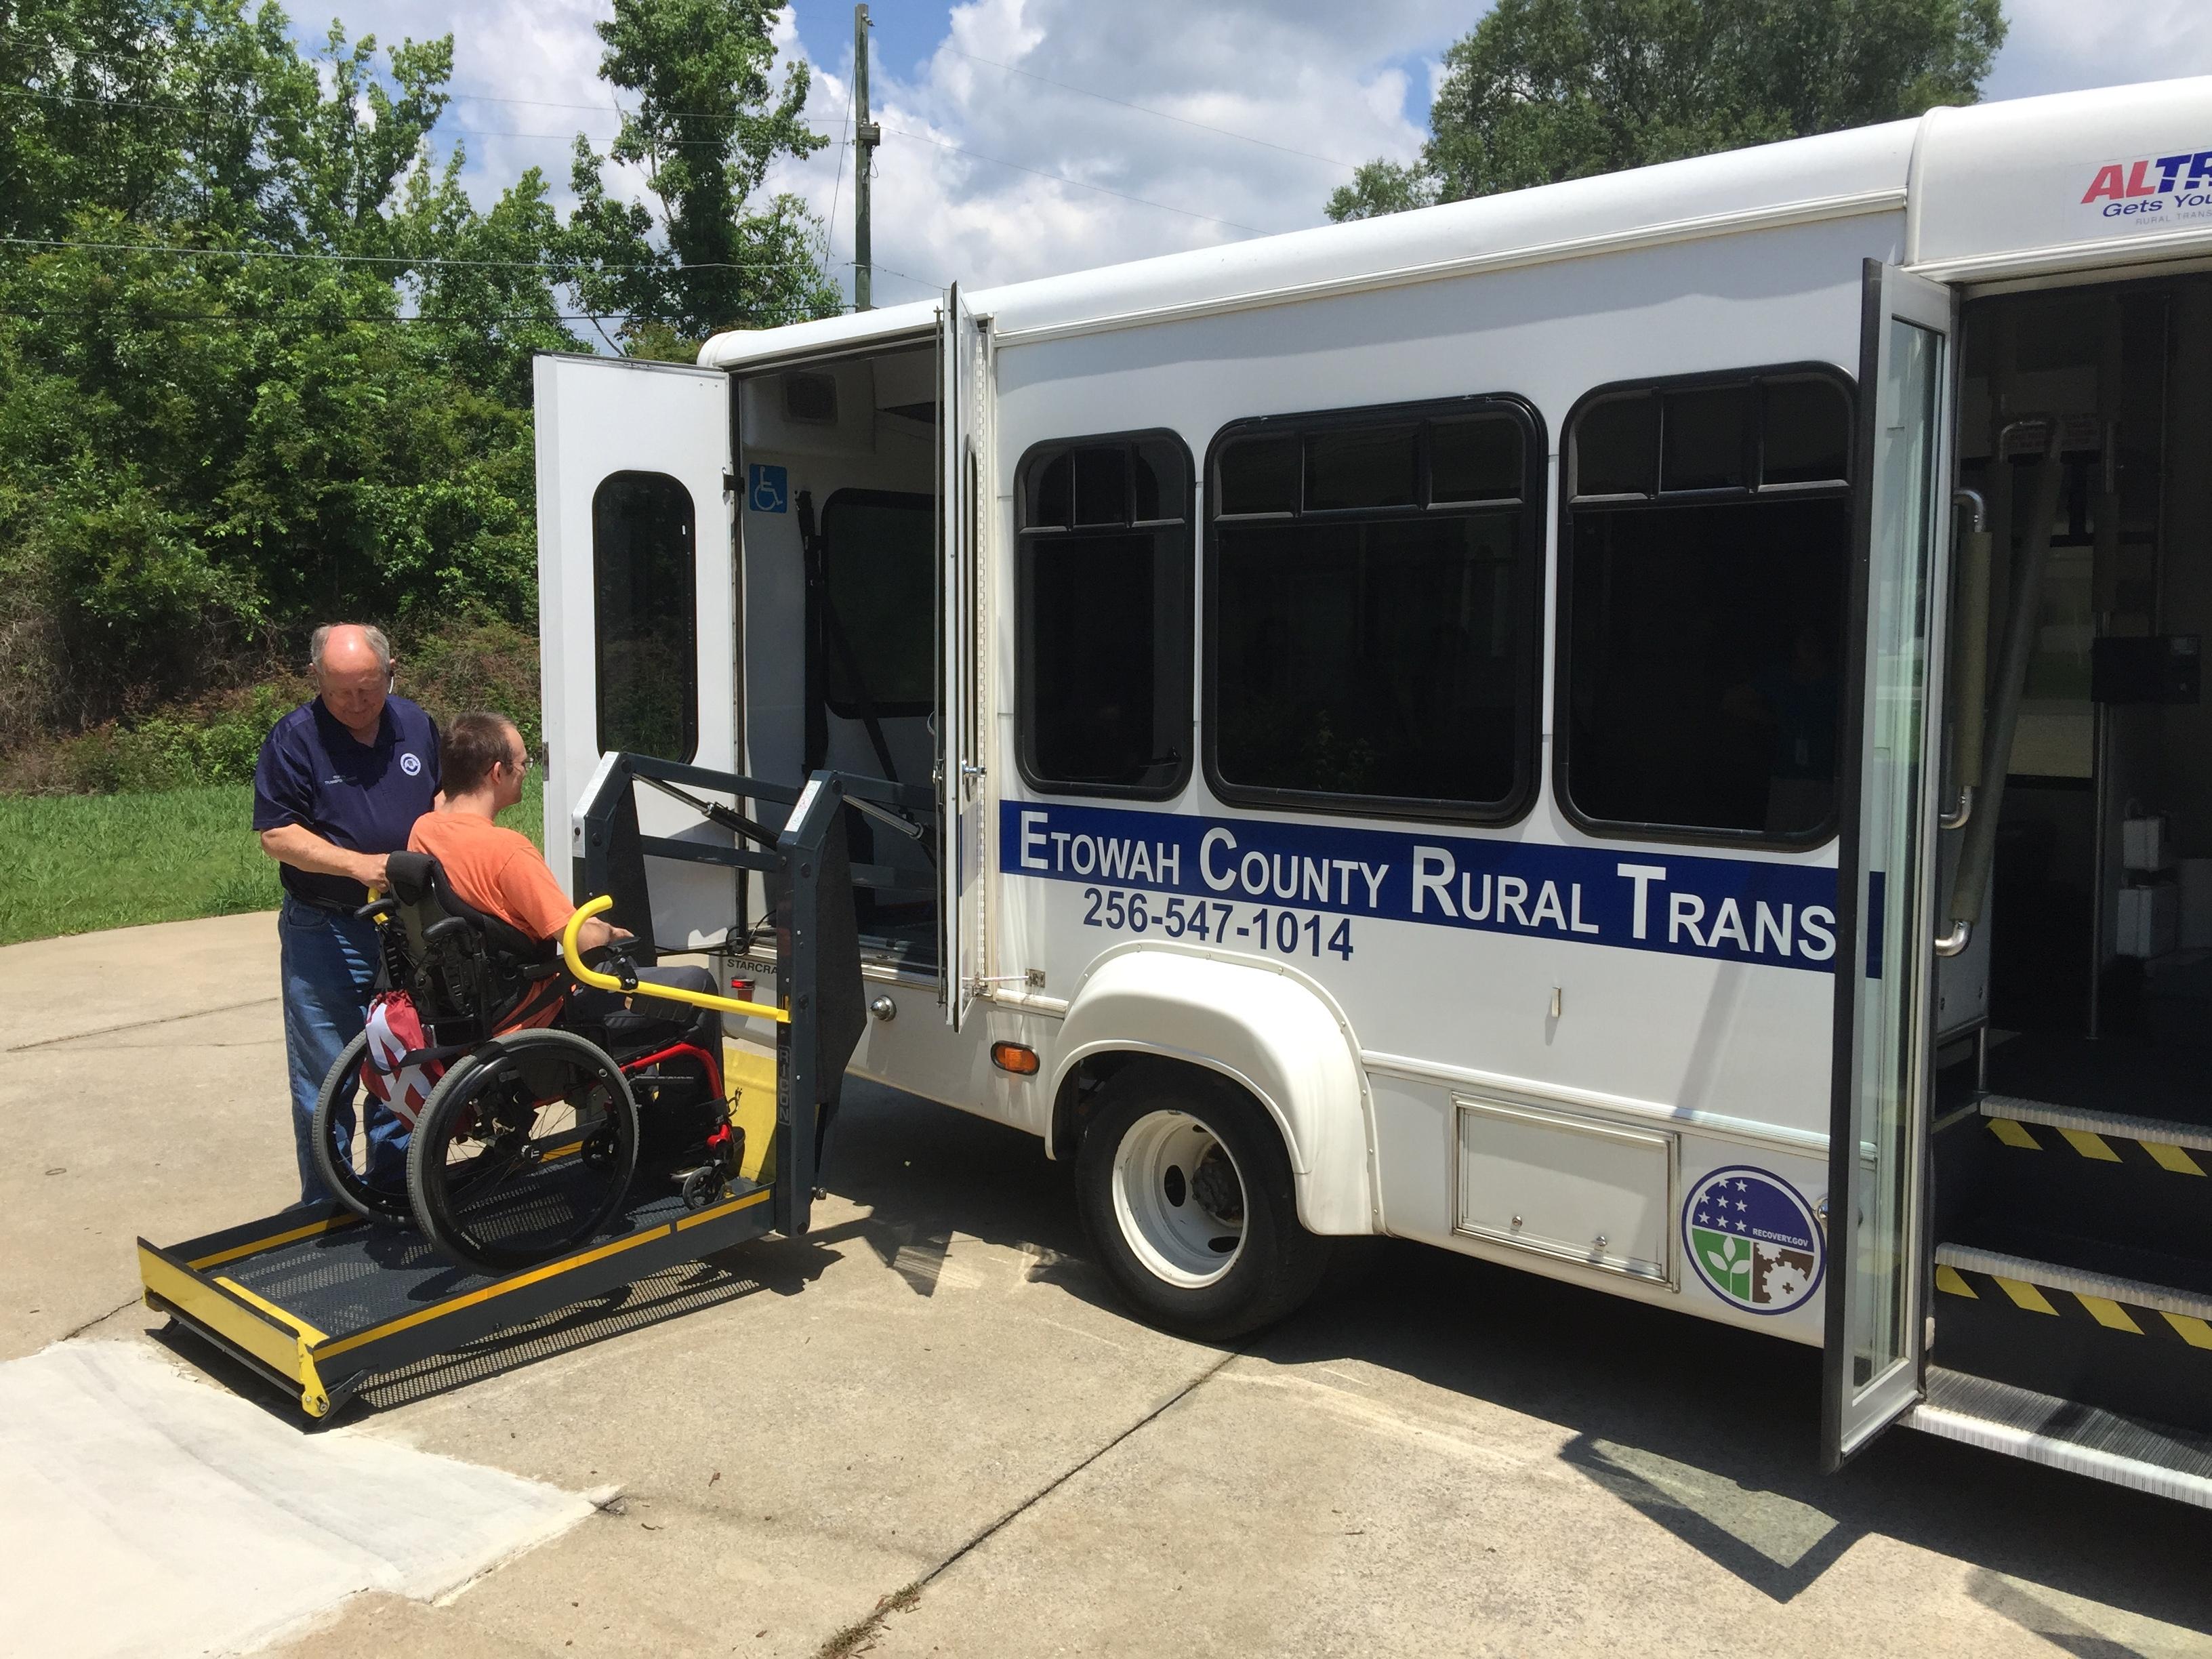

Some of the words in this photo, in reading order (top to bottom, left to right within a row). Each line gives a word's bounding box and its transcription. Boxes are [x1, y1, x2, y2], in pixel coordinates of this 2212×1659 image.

[2103, 200, 2163, 217] Gets
[2135, 215, 2171, 226] RURAL
[2177, 209, 2212, 220] TRANS
[1020, 811, 1180, 885] ETOWAH
[1200, 827, 1389, 909] COUNTY
[1412, 845, 1599, 934] RURAL
[1617, 863, 1837, 961] TRANS
[1083, 888, 1354, 962] 256-547-1014
[727, 958, 777, 975] STARCRA
[1753, 1228, 1809, 1247] RECOVERY.GOV
